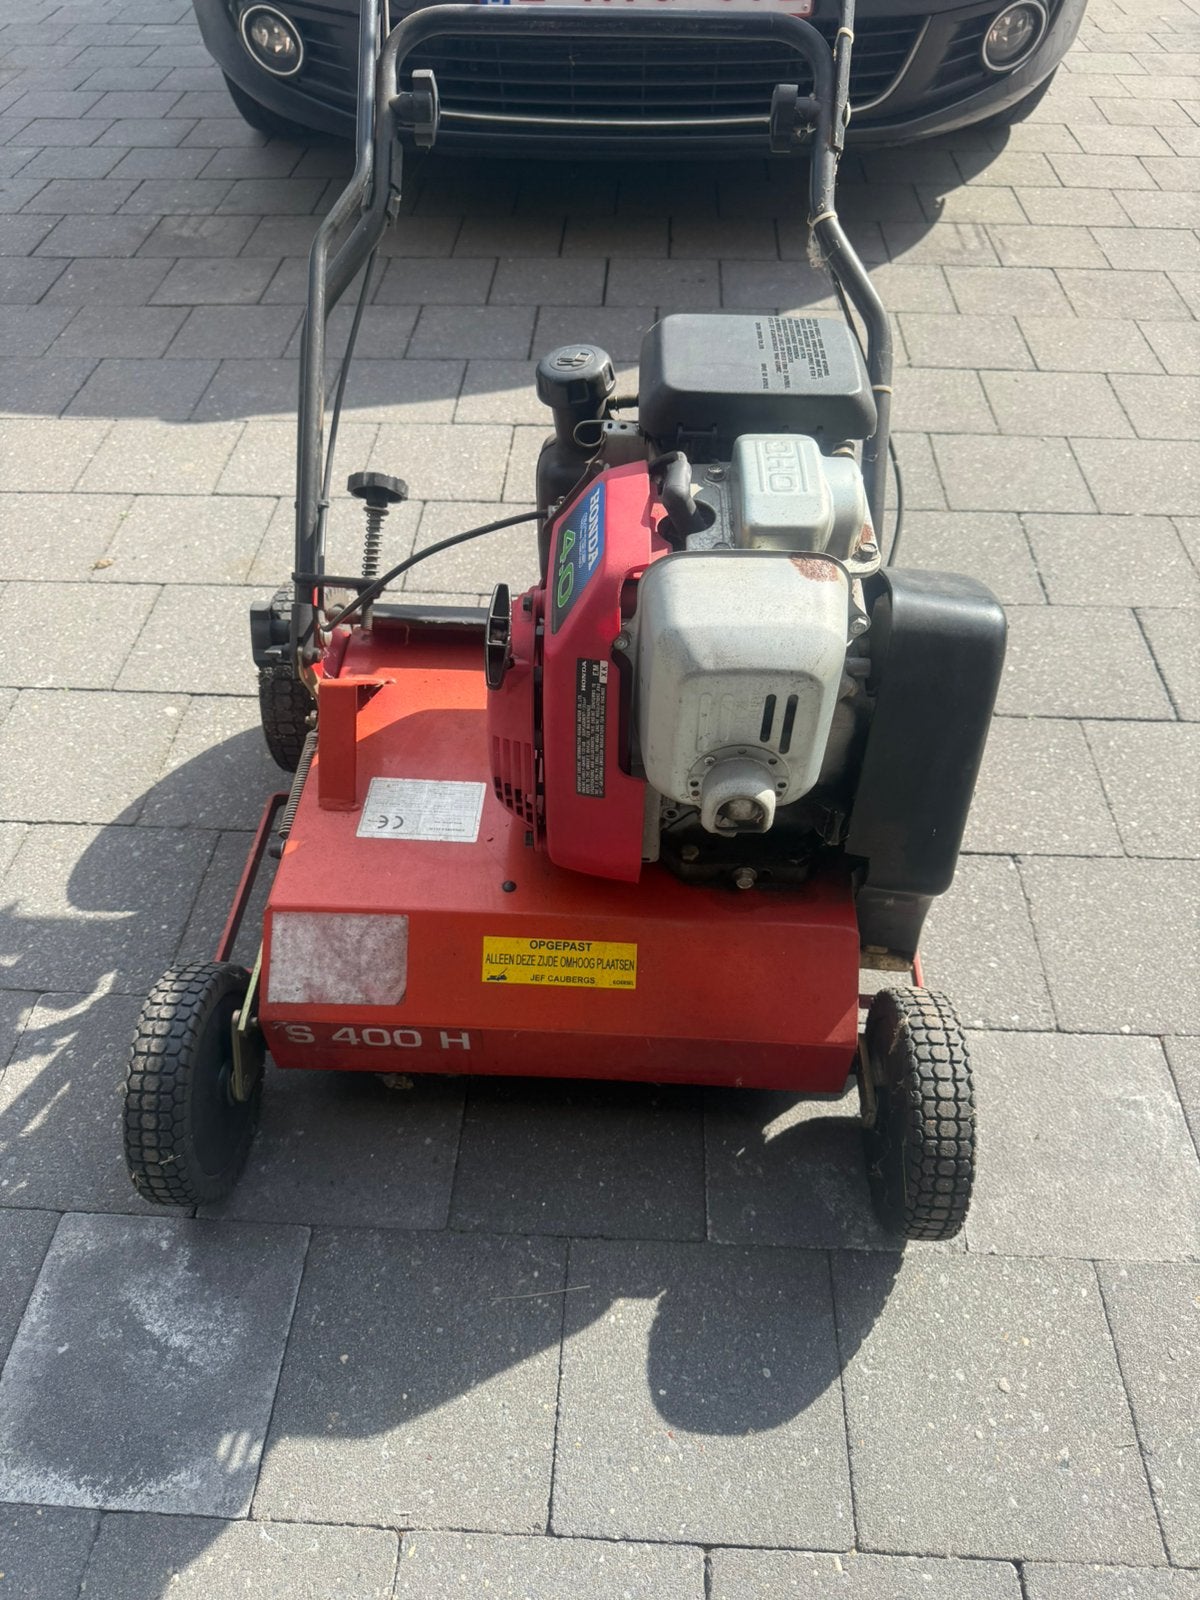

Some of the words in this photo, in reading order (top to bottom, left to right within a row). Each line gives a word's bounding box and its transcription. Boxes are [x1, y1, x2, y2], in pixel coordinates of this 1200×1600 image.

[764, 441, 797, 492] OHC
[588, 488, 600, 571] HONDA
[529, 939, 593, 952] OPGEPAST
[485, 953, 515, 965] ALLEEN
[516, 954, 536, 966] DEZE
[537, 955, 558, 967] ZIJDE
[560, 956, 595, 969] OMHOOG
[596, 958, 635, 971] PLAATSEN
[530, 973, 545, 982] JEF
[547, 974, 596, 985] CAUBERGS
[331, 1026, 422, 1048] 400
[440, 1030, 471, 1050] H
